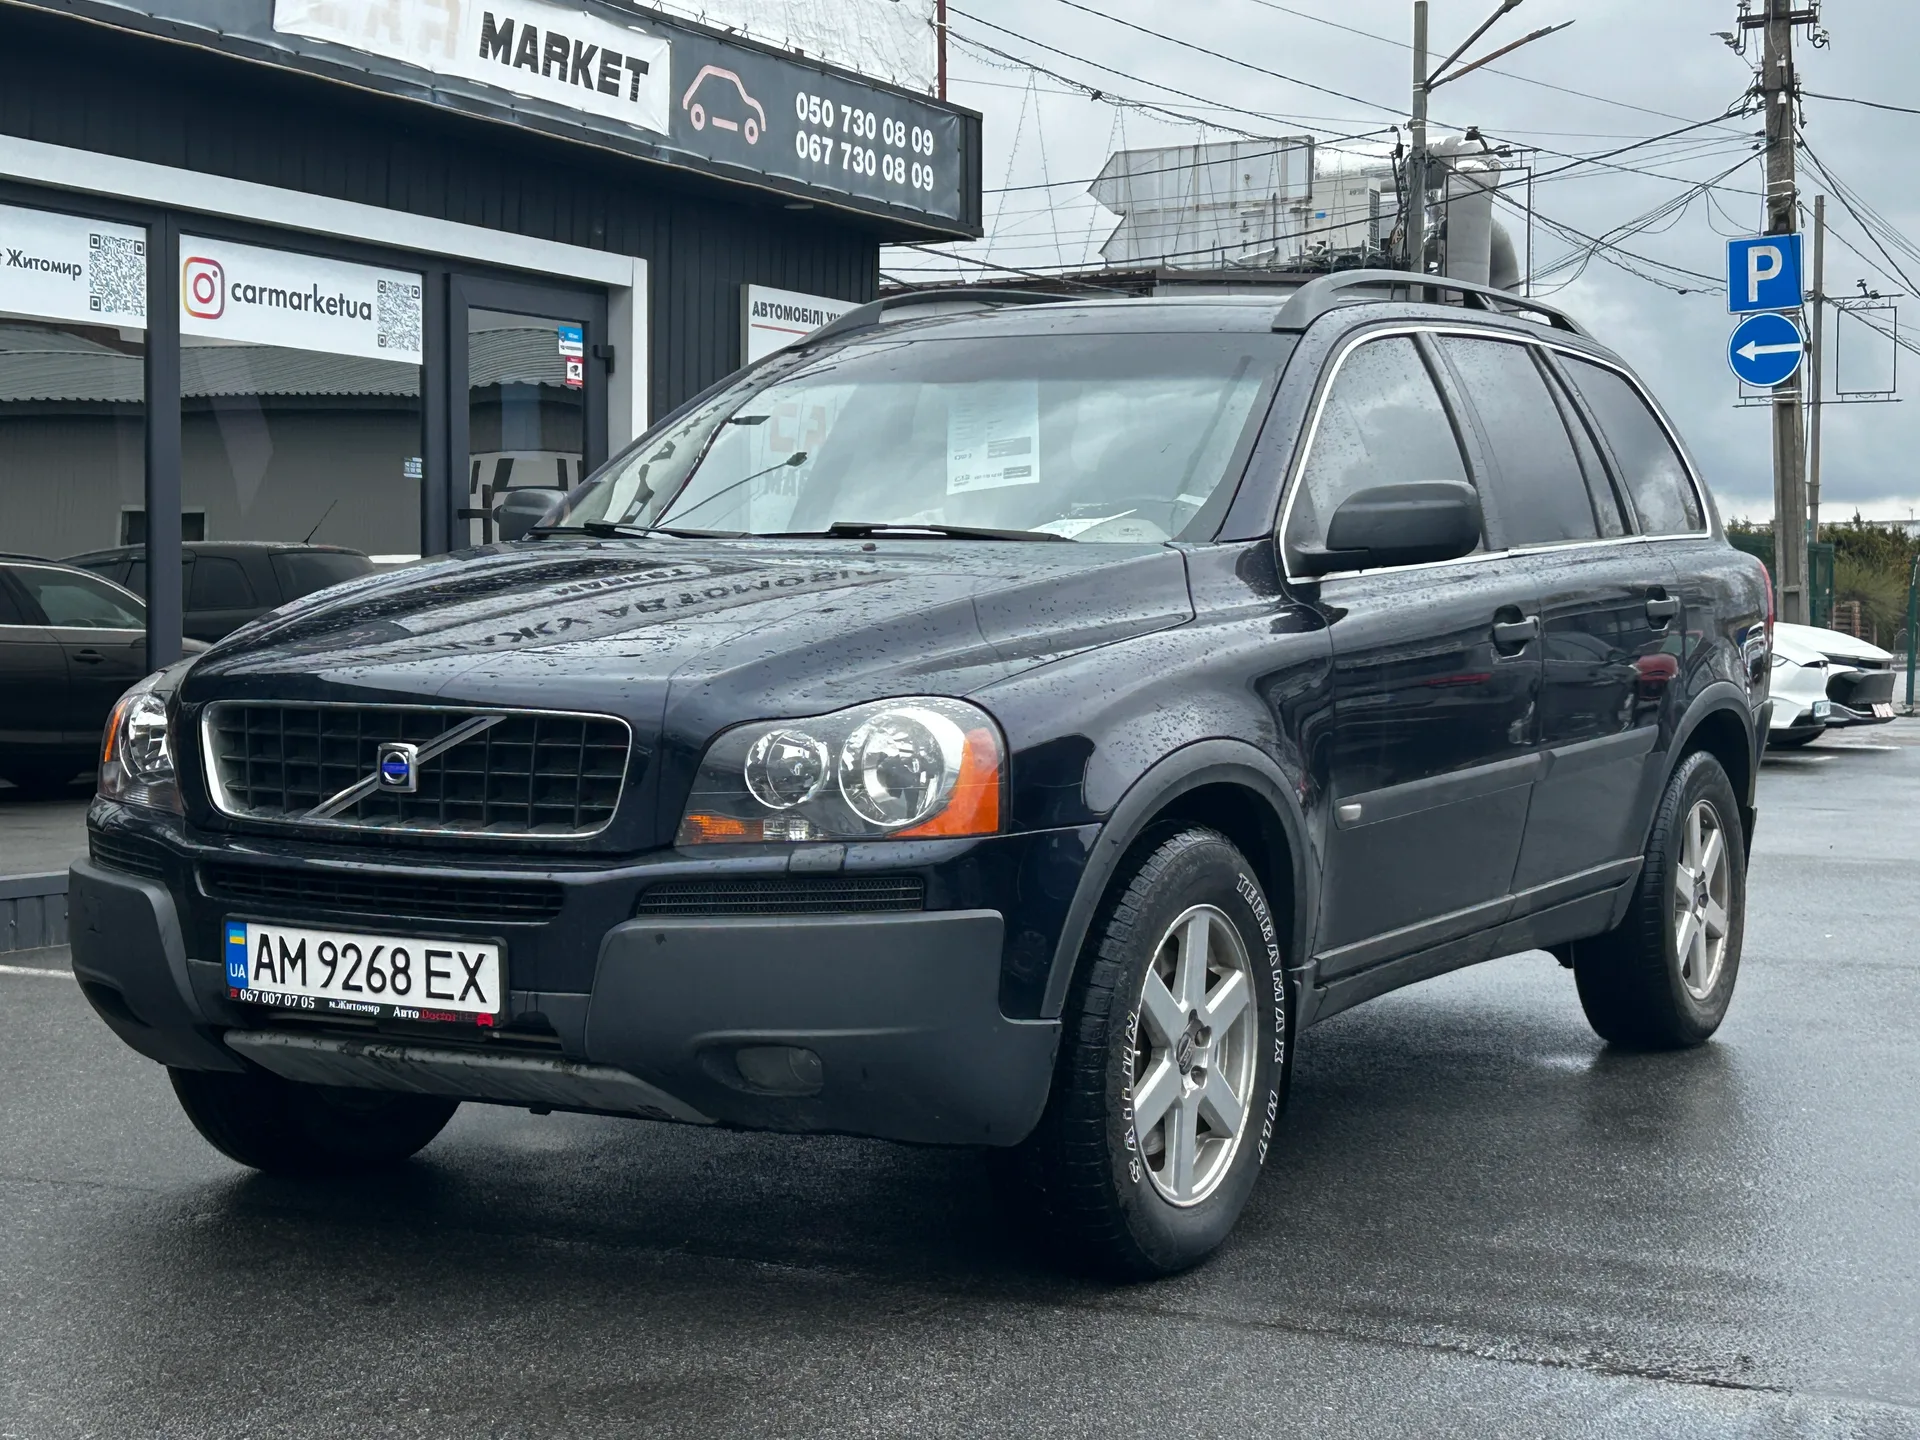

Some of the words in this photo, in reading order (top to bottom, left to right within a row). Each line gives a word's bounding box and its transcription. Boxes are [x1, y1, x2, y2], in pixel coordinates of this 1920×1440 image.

[479, 11, 650, 102] MARKET
[796, 92, 834, 128] 050
[841, 105, 876, 140] 730
[883, 117, 906, 148] 08
[911, 126, 934, 156] 09
[796, 130, 833, 165] 067
[841, 142, 876, 176] 730
[883, 154, 906, 184] 08
[911, 162, 934, 191] 09
[6, 248, 82, 281] Житомир
[1748, 245, 1783, 303] P
[231, 282, 372, 321] carmarketua
[752, 301, 824, 326] АВТОМОБІЛІ
[229, 963, 246, 978] UA
[253, 933, 307, 987] AM
[317, 940, 411, 996] 9268
[425, 949, 487, 1003] EX
[240, 988, 260, 1001] 067
[261, 991, 281, 1005] 007
[284, 994, 299, 1008] 07
[301, 997, 315, 1009] 05
[393, 1006, 419, 1019] Авто
